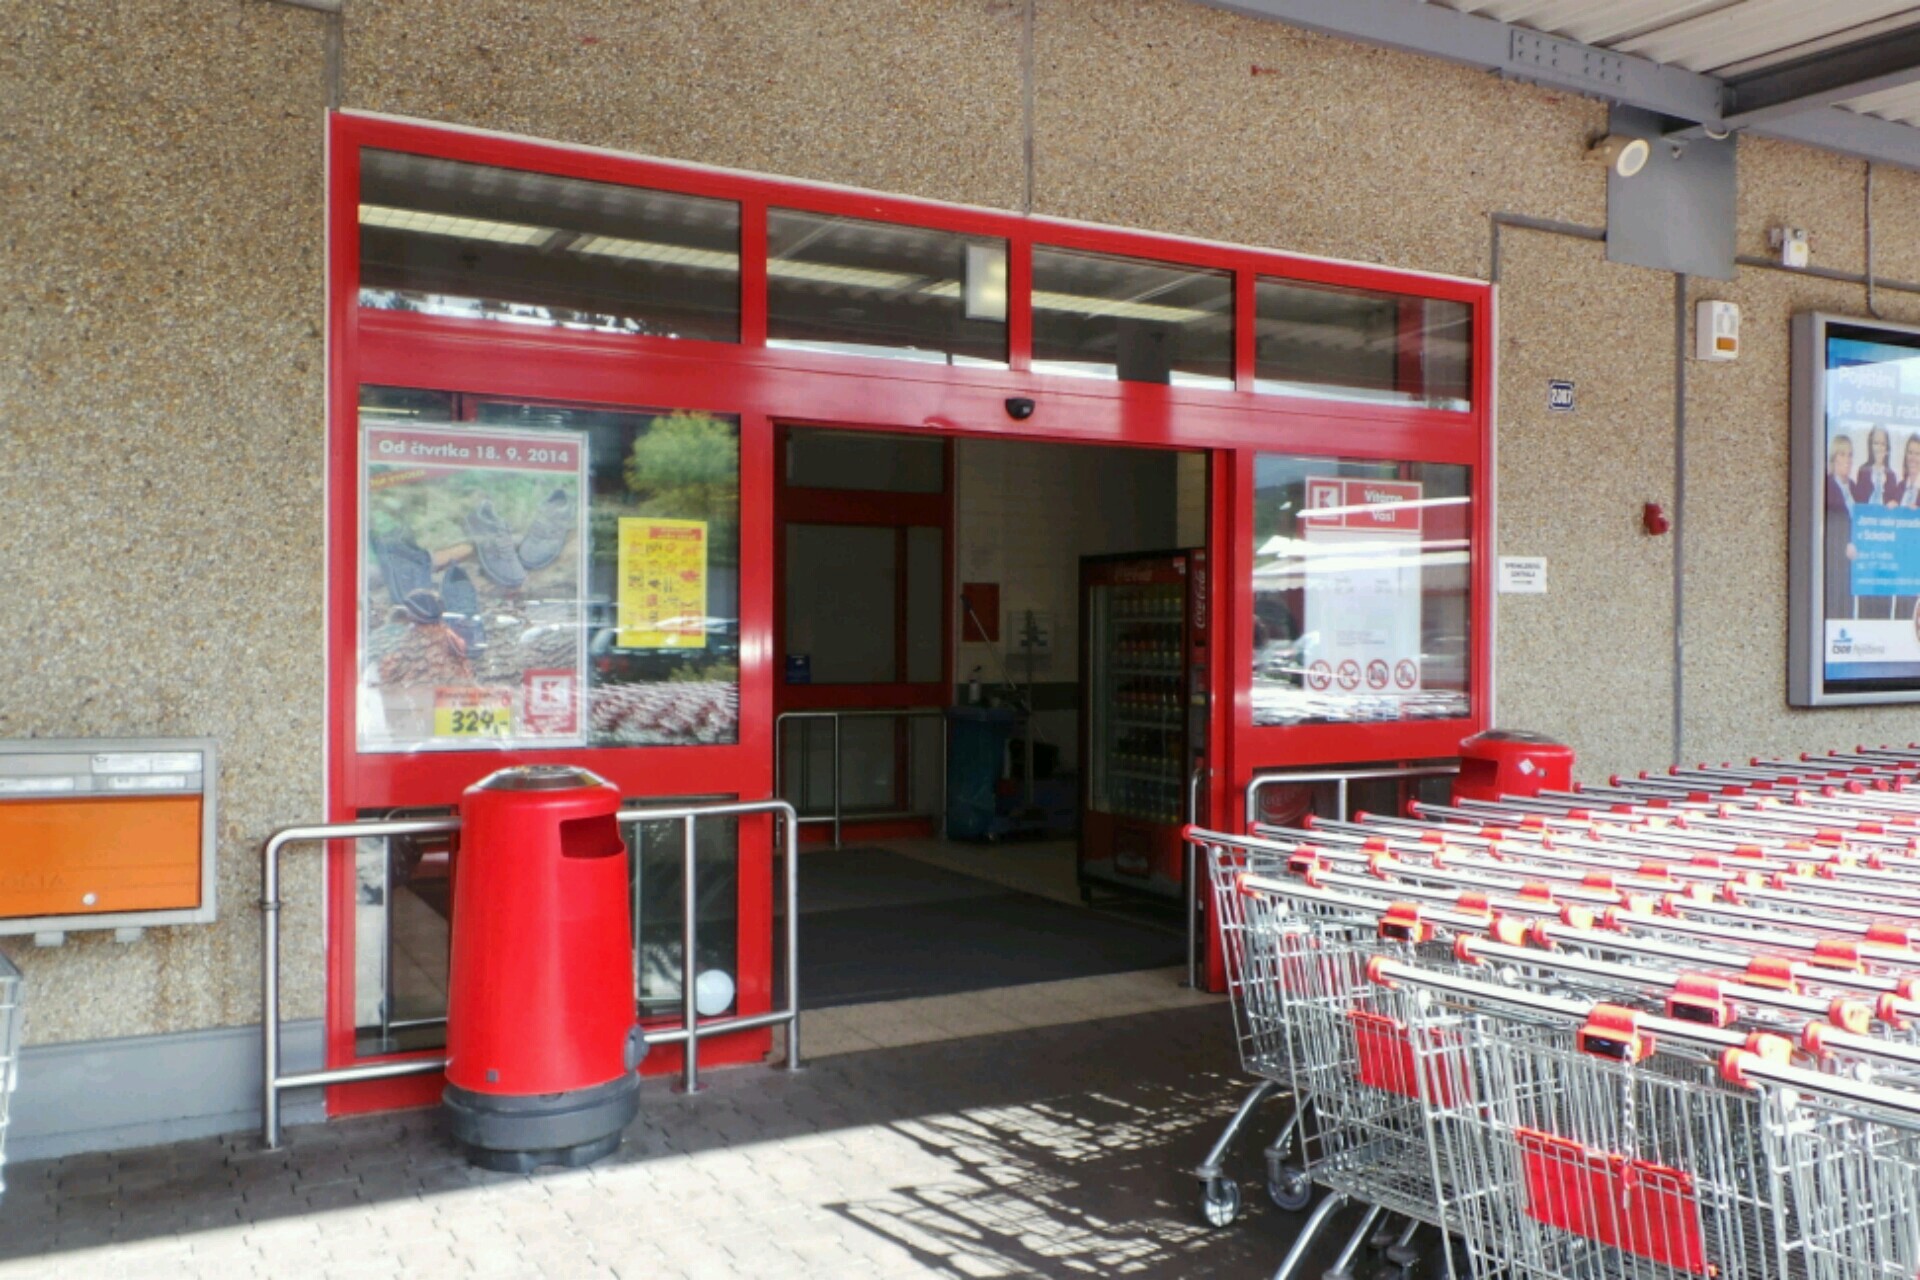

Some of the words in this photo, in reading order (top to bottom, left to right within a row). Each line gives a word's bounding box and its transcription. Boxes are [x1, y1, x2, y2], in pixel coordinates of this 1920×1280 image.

[379, 440, 404, 454] Od
[411, 440, 470, 458] čtvrtka
[477, 446, 500, 460] 18.
[506, 448, 522, 461] 9.
[528, 449, 569, 463] 2014
